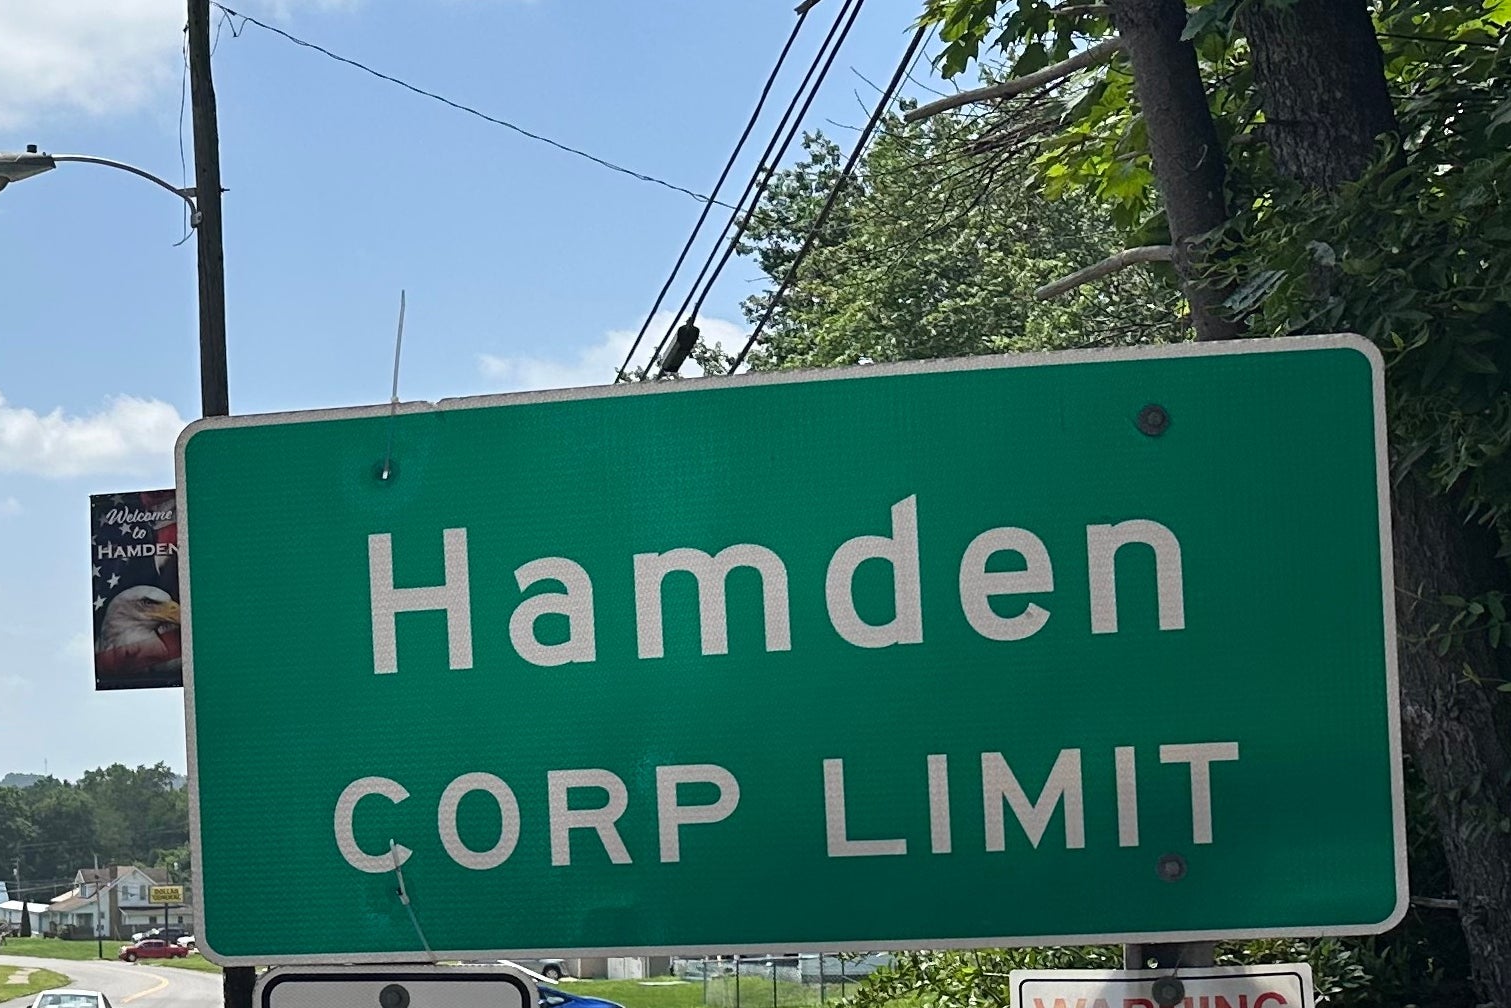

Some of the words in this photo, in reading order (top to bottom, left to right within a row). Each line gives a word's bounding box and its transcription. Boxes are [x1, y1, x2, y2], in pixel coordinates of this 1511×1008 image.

[105, 506, 172, 525] Welcome
[132, 526, 147, 539] to
[367, 492, 1187, 676] Hamden
[332, 762, 742, 873] CORP
[822, 740, 1240, 859] LIMIT
